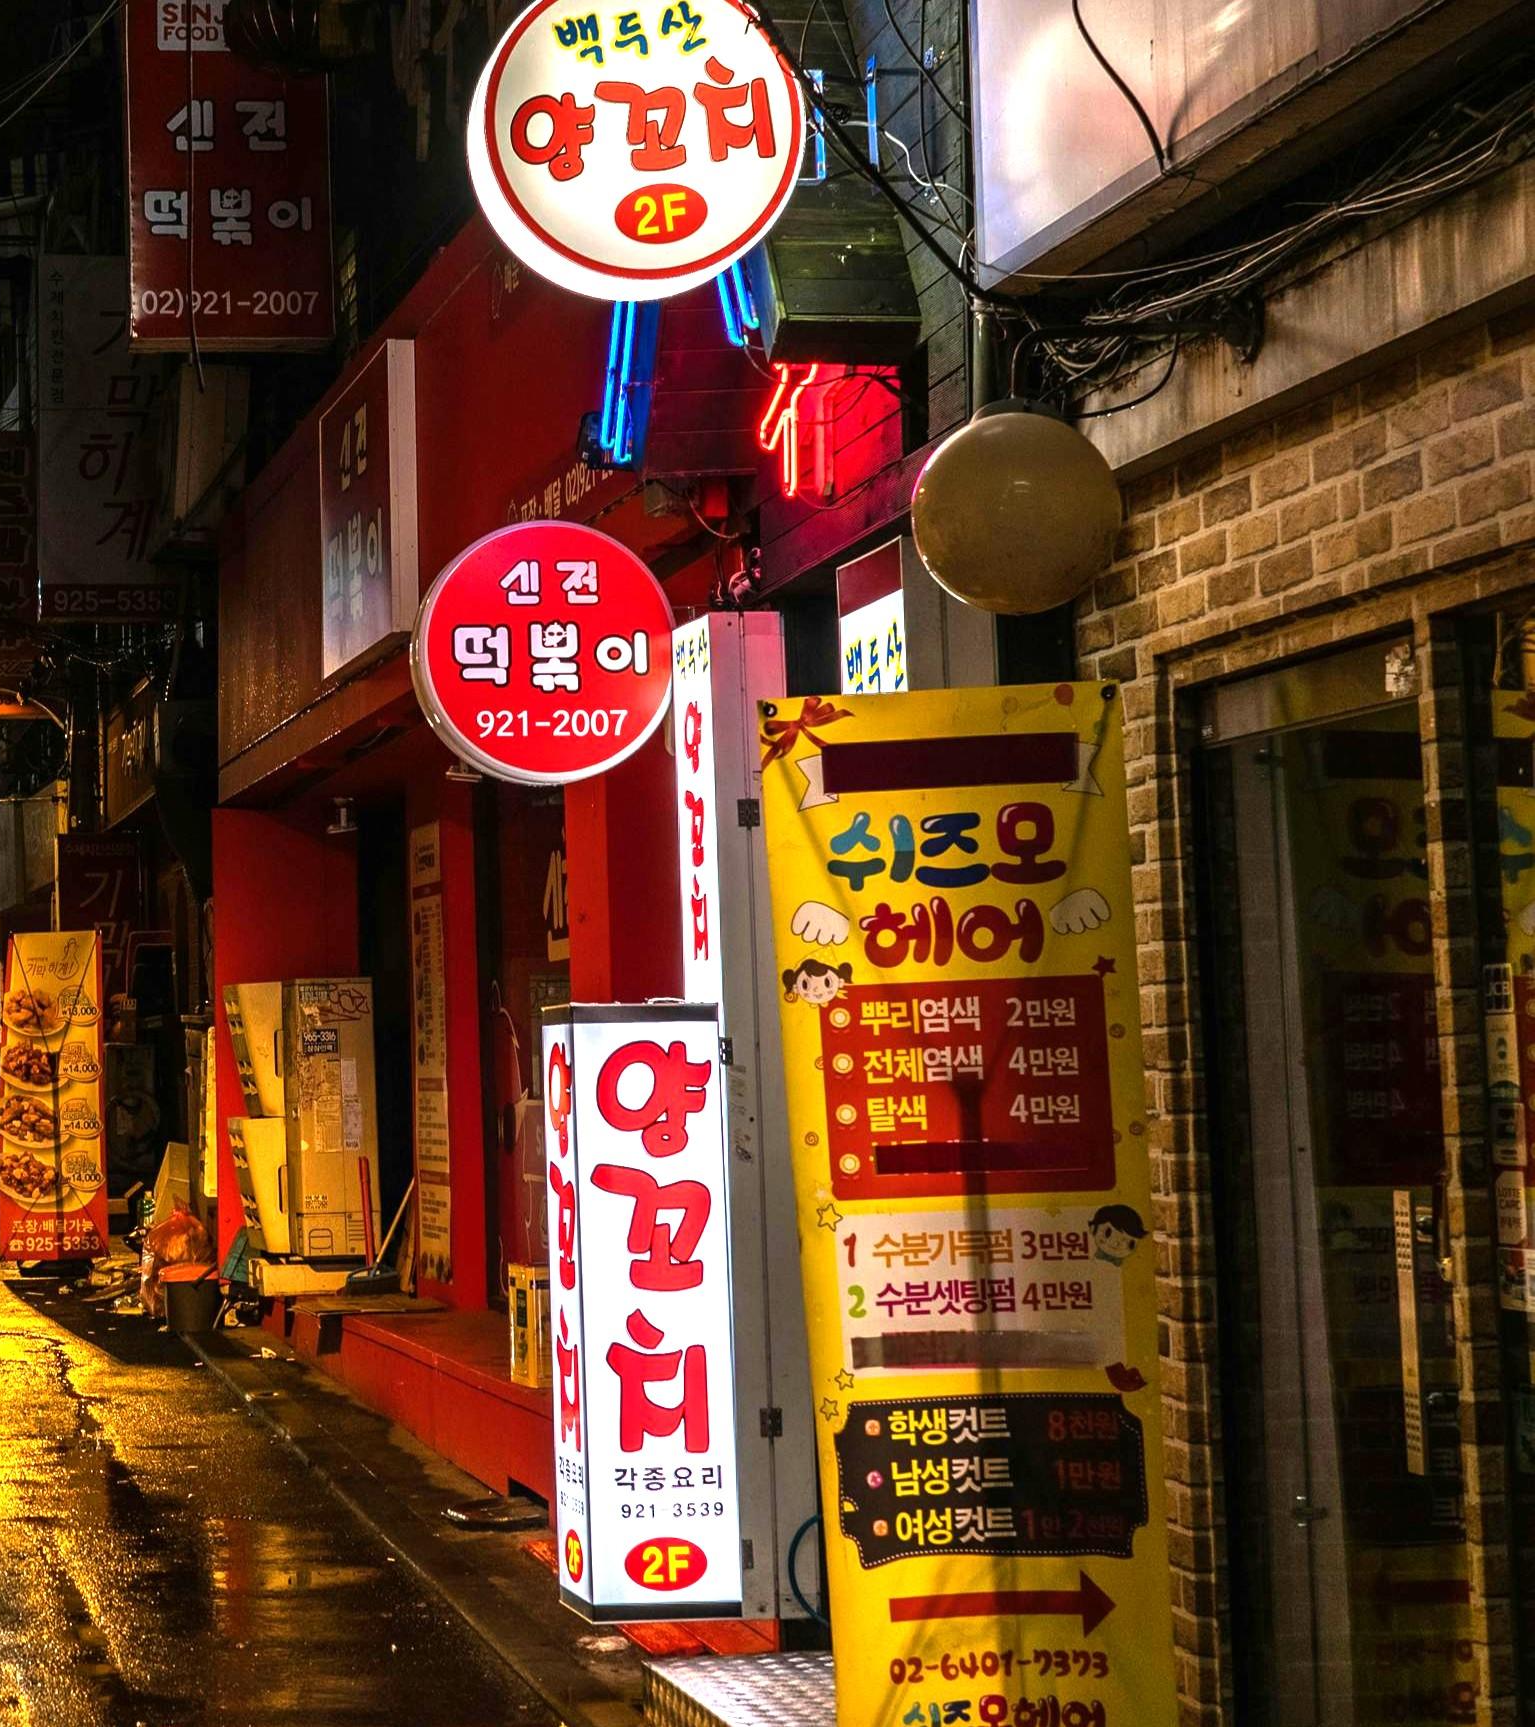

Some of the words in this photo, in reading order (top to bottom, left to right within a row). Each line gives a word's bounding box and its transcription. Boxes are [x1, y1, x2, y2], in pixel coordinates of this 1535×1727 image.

[163, 26, 221, 41] FOOD
[555, 1, 706, 64] 백두산
[166, 100, 287, 152] 신전
[510, 55, 776, 181] 양꼬치
[144, 189, 313, 247] 떡볶이
[634, 192, 687, 237] 2F
[141, 290, 319, 319] 02)921-2007
[339, 403, 368, 492] 신전
[327, 507, 383, 620] 떡볶이
[500, 560, 599, 605] 신전
[452, 621, 649, 693] 떡볶이
[675, 628, 709, 679] 백두산
[846, 619, 905, 695] 백두산
[476, 710, 628, 738] 921-2007
[683, 701, 709, 960] 양꼬치
[860, 896, 1044, 968] 헤어
[860, 996, 981, 1036] 뿌리염색
[1006, 997, 1076, 1029] 2만원
[864, 1045, 984, 1084] 전체염색
[1009, 1047, 1079, 1078] 4만원
[867, 1094, 928, 1132] 탈색
[1009, 1095, 1081, 1125] 4만원
[548, 1041, 582, 1452] 양꼬치
[591, 1039, 712, 1455] 양꼬치
[843, 1233, 857, 1268] 1
[872, 1228, 1014, 1268] 수분가득펌
[1021, 1230, 1090, 1262] 3만원
[848, 1286, 866, 1318] 2
[876, 1278, 1016, 1318] 수분셋팅펌
[1022, 1280, 1093, 1312] 4만원
[888, 1407, 1011, 1445] 학생컷트
[1048, 1410, 1120, 1442] 8천원
[614, 1465, 723, 1491] 각종요리
[891, 1458, 1014, 1496] 남성컷트
[1056, 1459, 1121, 1490] 1만원
[895, 1506, 1017, 1546] 여성컷트
[567, 1535, 582, 1575] 2F
[642, 1546, 690, 1583] 2F
[889, 1649, 1110, 1684] 02-6401-7373
